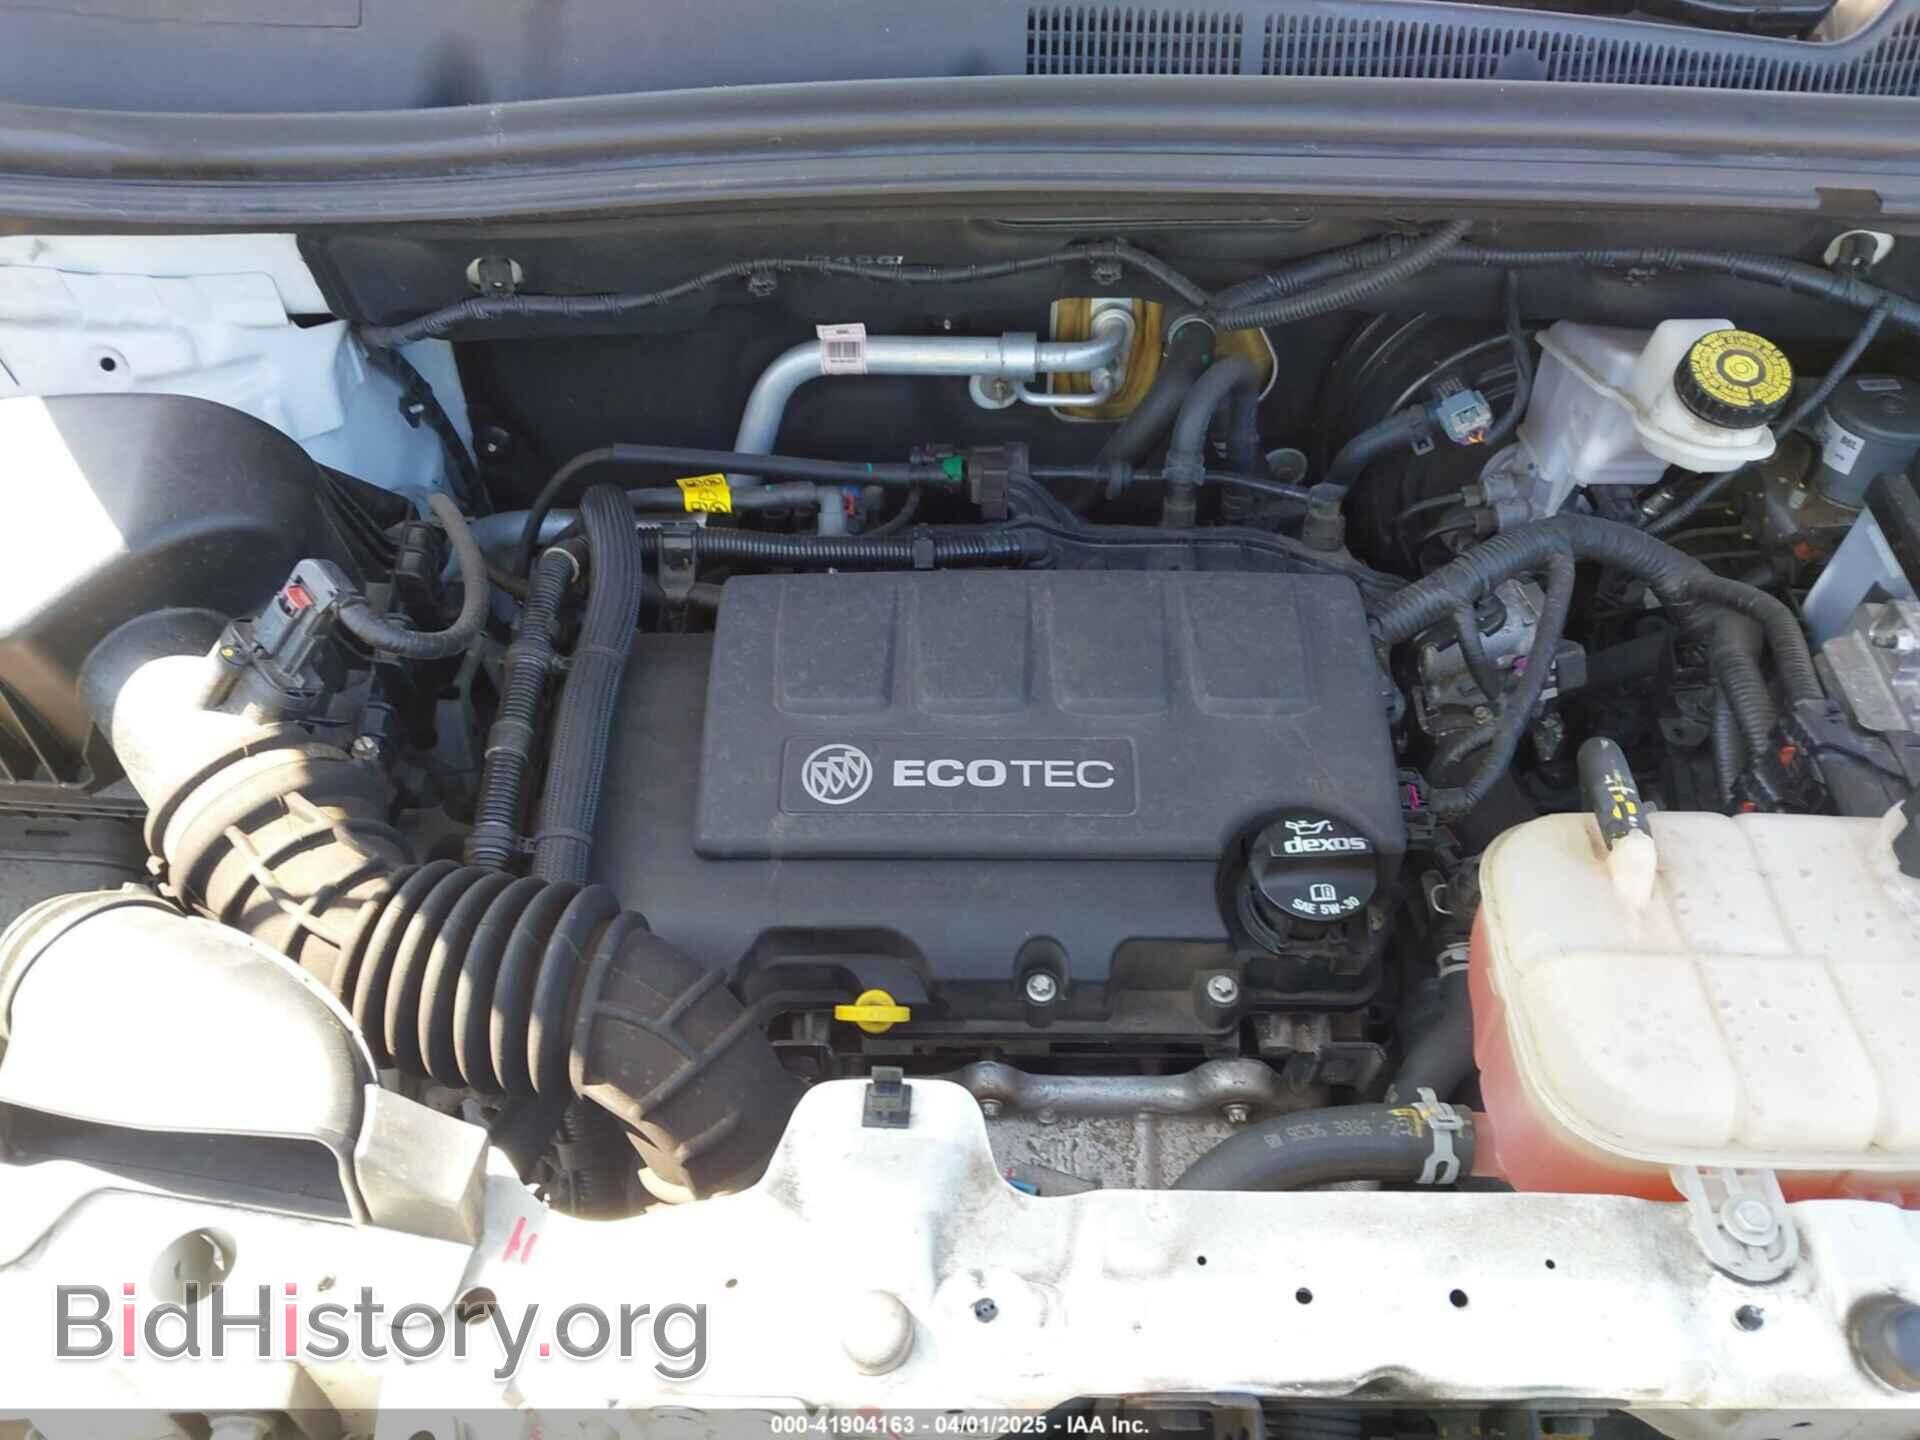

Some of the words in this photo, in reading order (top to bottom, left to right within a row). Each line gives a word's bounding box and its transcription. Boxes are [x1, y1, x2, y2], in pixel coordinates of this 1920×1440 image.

[893, 759, 1115, 788] ECOTEC
[1284, 836, 1368, 853] dexos
[1292, 898, 1317, 914] SAE
[1320, 896, 1360, 914] 5W-30
